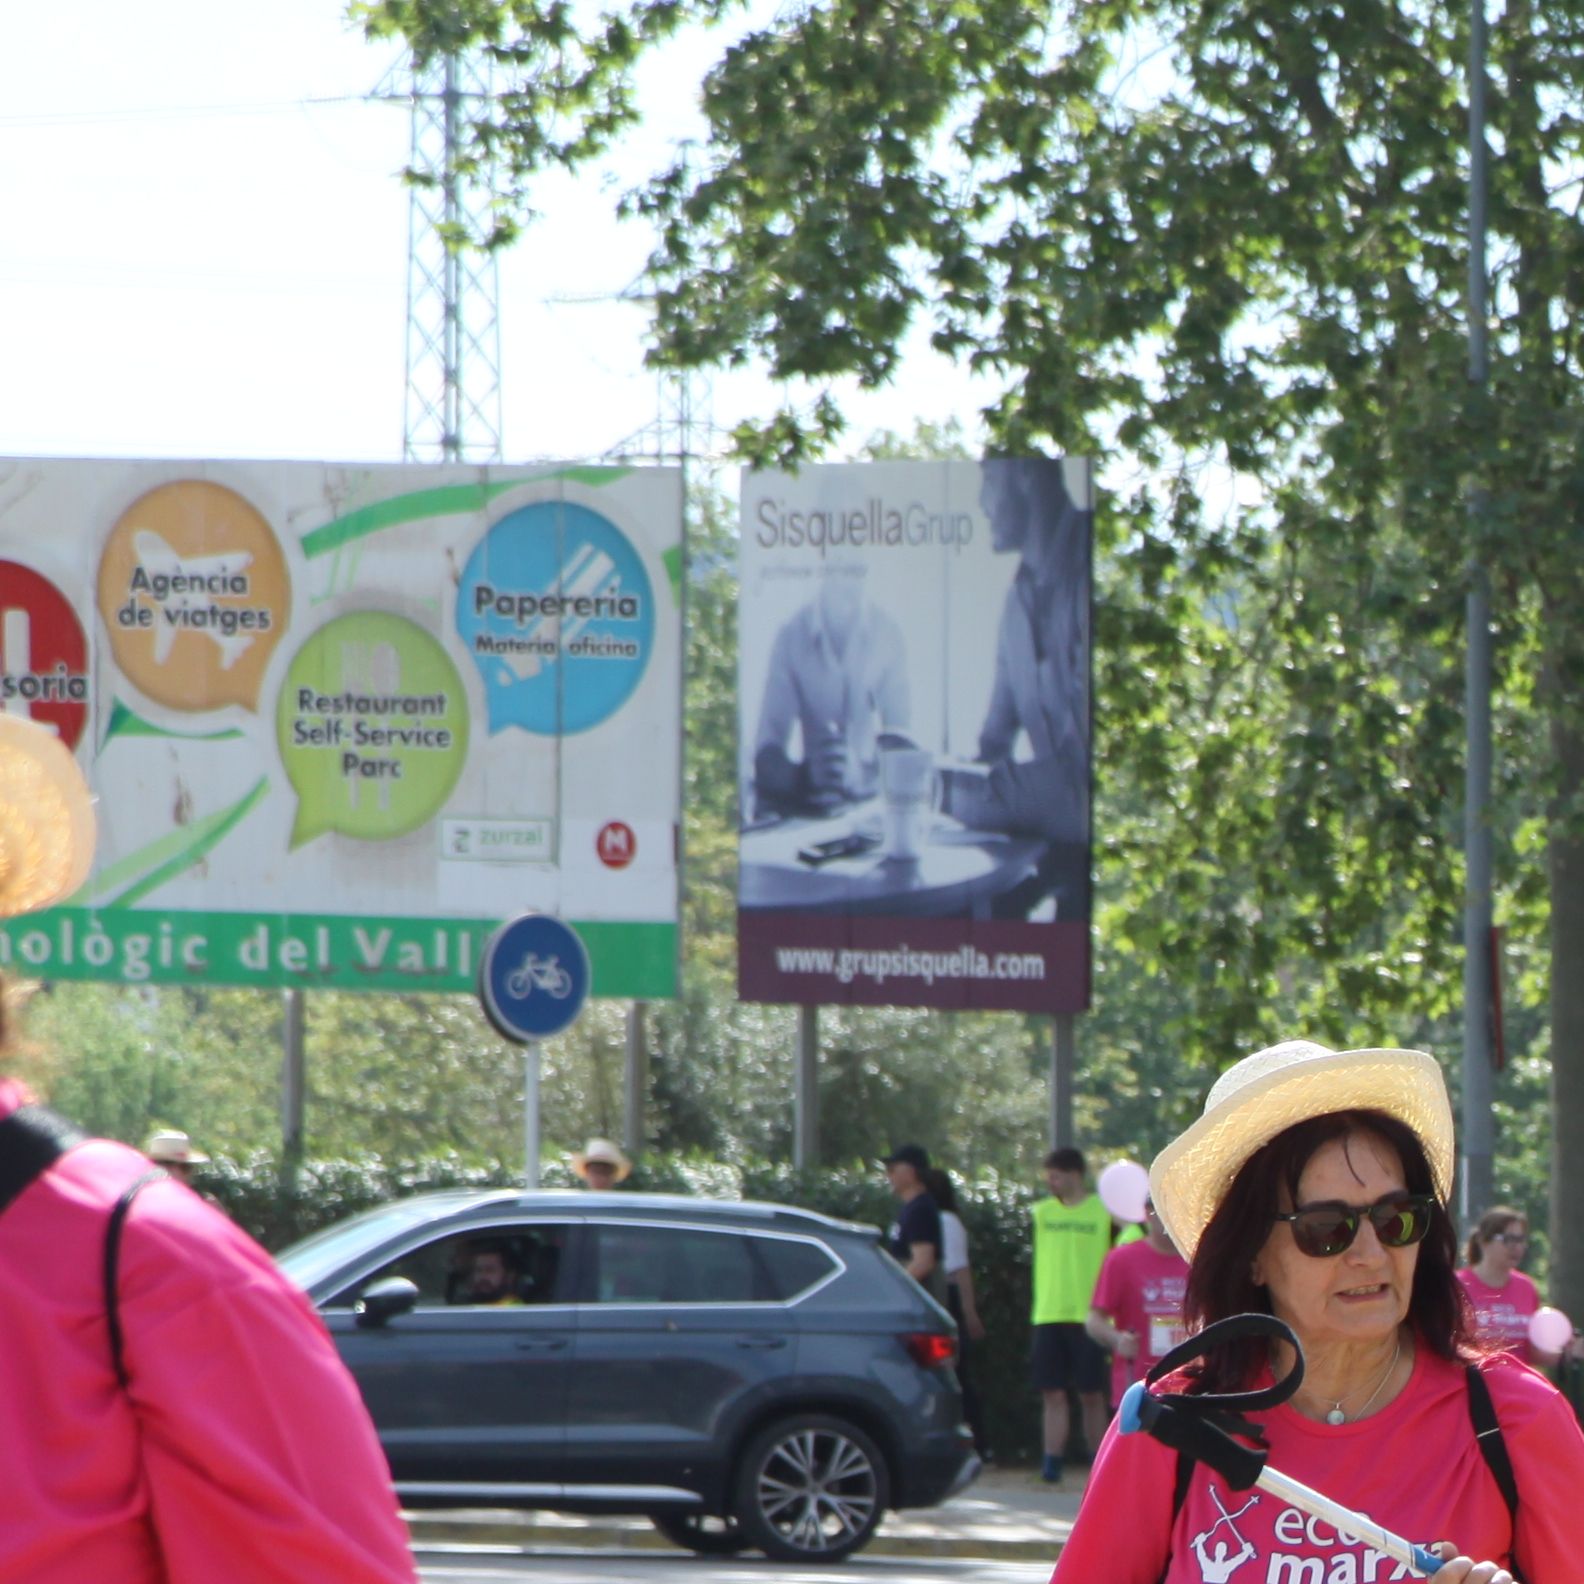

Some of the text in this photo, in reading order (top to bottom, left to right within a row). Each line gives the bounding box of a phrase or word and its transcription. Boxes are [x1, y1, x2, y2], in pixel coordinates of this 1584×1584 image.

[755, 498, 973, 554] SisquellaGrup
[131, 565, 248, 599] Agència
[118, 600, 270, 637] de viatges
[474, 584, 639, 629] Papereria
[569, 634, 638, 659] oficina
[1, 664, 88, 699] soria
[299, 689, 446, 717] Restaurant
[293, 720, 451, 749] Self-Service
[342, 752, 402, 779] Parc
[238, 924, 330, 972] del
[353, 927, 471, 977] Vall
[776, 944, 1045, 985] www.grupsisquella.com
